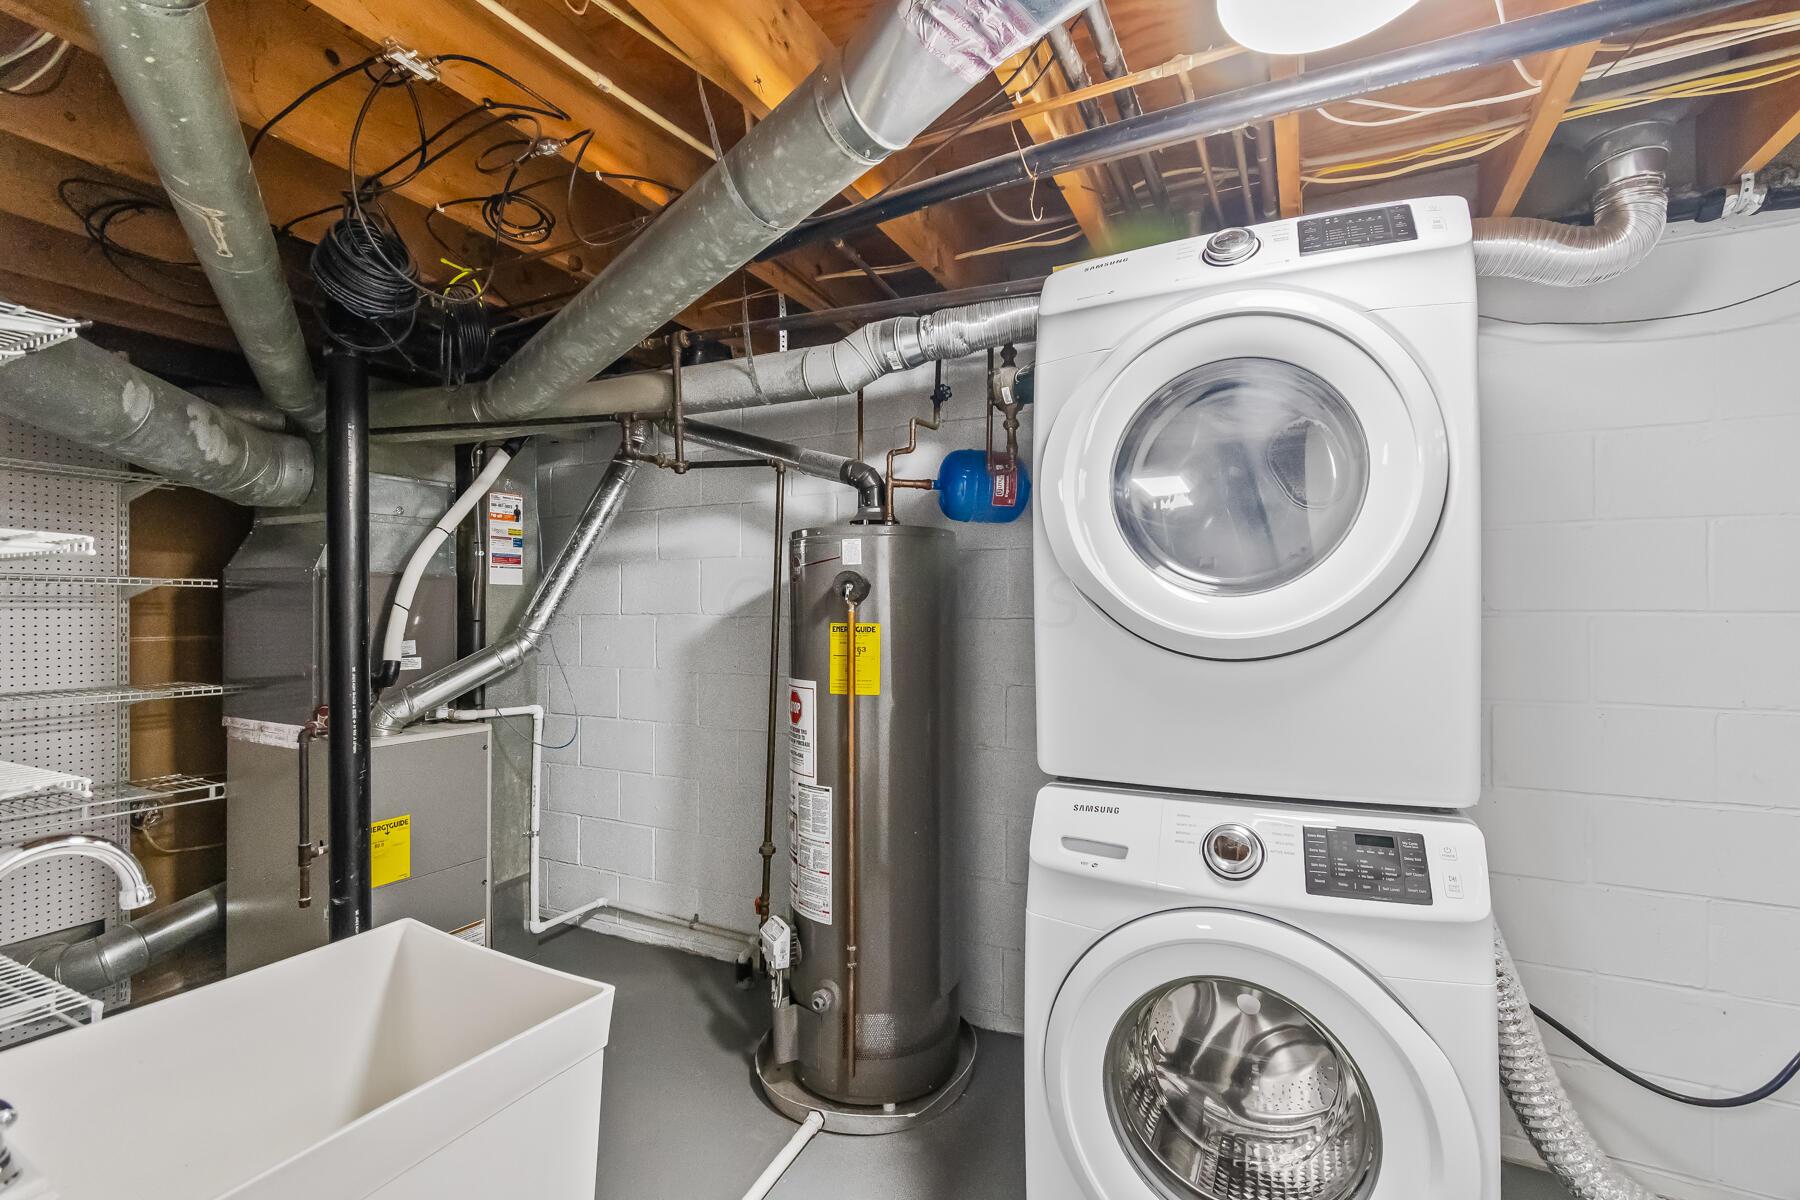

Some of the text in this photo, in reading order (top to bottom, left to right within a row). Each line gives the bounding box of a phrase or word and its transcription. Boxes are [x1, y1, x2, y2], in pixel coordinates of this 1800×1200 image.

[1083, 257, 1129, 272] SAMSUNG
[832, 625, 876, 633] ENERGUIDE
[1072, 803, 1120, 815] SAMSUNG
[370, 818, 409, 835] ERGYGUIDE
